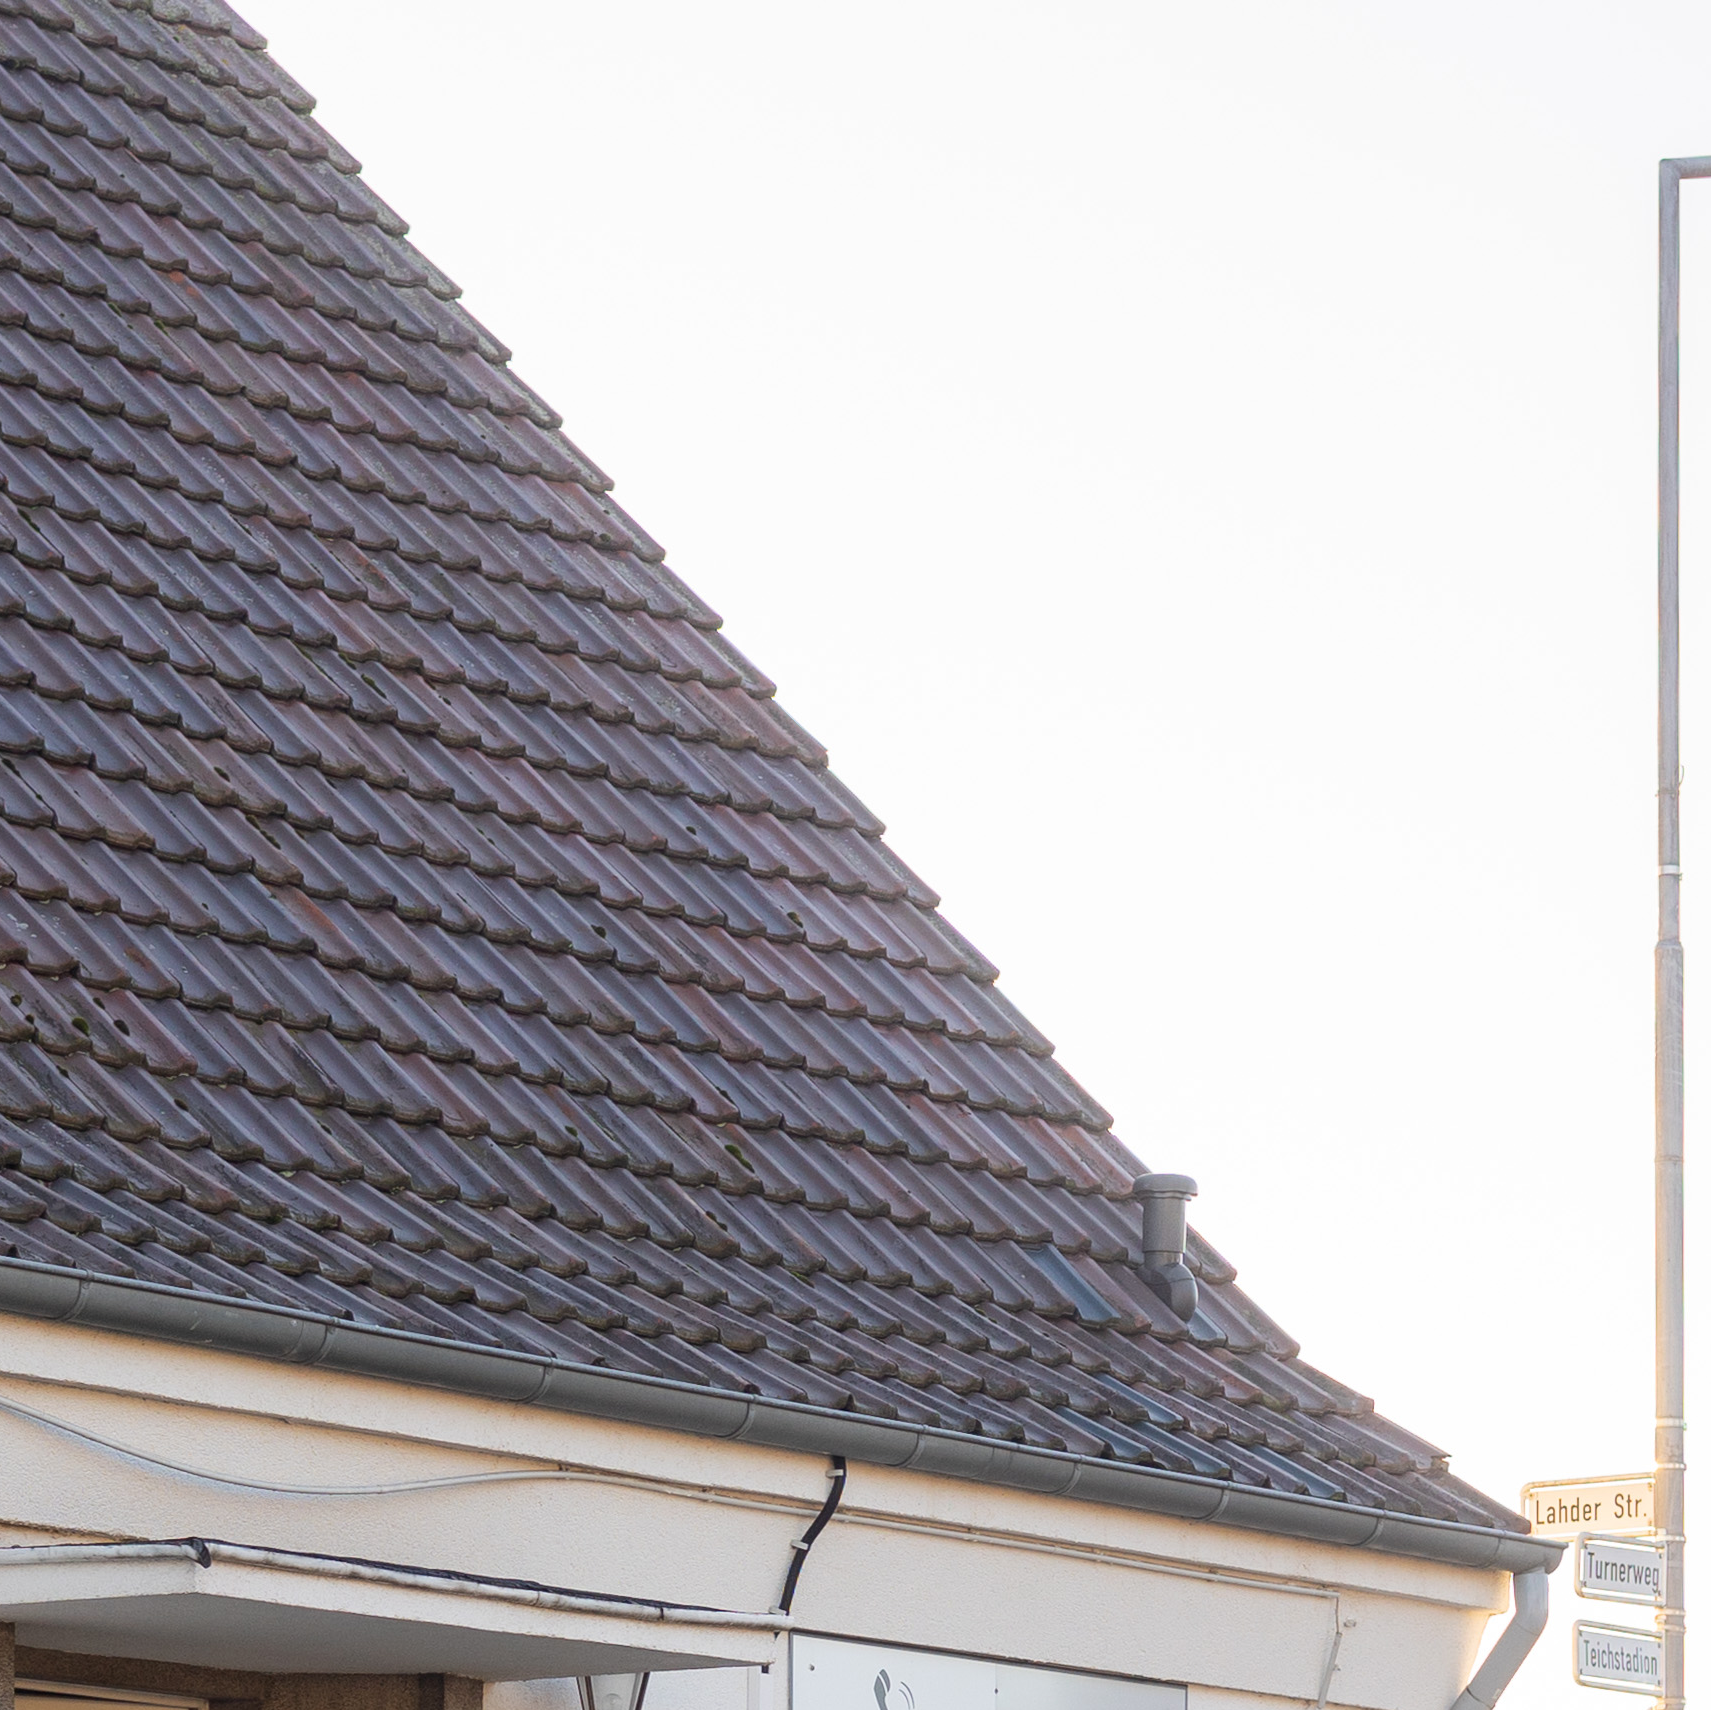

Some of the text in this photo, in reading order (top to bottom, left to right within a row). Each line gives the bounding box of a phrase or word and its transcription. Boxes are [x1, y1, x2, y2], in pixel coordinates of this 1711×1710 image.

[1536, 1492, 1648, 1526] Lahder Str.
[1587, 1551, 1660, 1594] Turnerweg
[1583, 1639, 1658, 1677] Teichstadion
